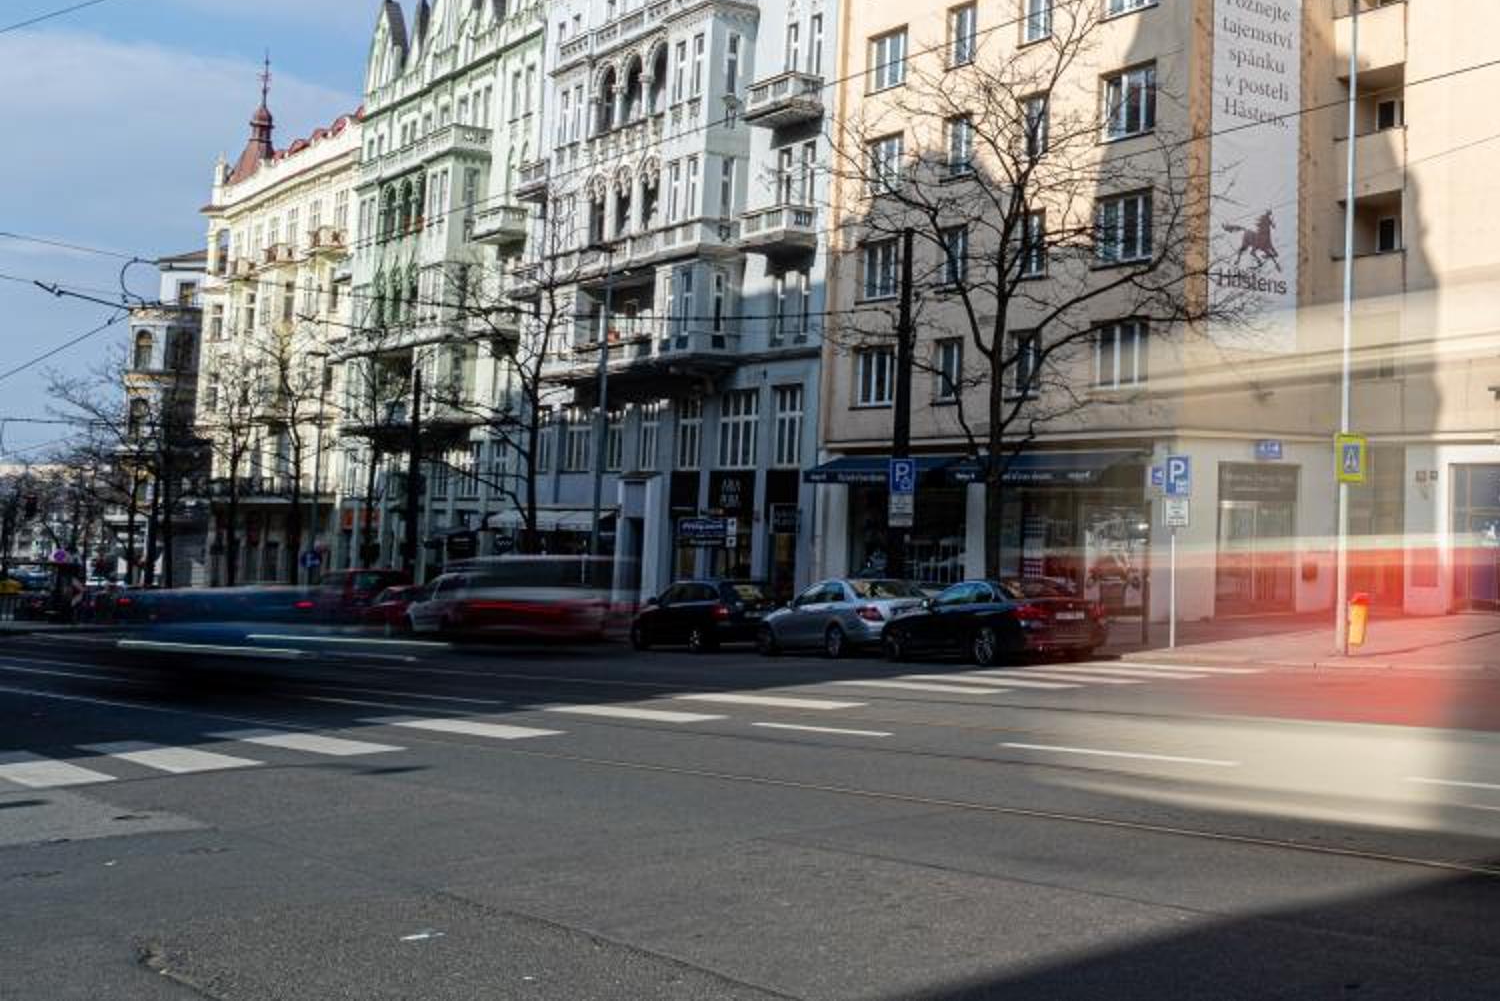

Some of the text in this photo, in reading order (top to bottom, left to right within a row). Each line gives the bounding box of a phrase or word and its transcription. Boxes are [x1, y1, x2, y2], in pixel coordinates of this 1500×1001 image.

[1222, 16, 1293, 49] tajemství
[1229, 48, 1285, 74] spánku
[1225, 74, 1289, 102] v posteli
[895, 462, 909, 482] P
[1169, 460, 1185, 483] P
